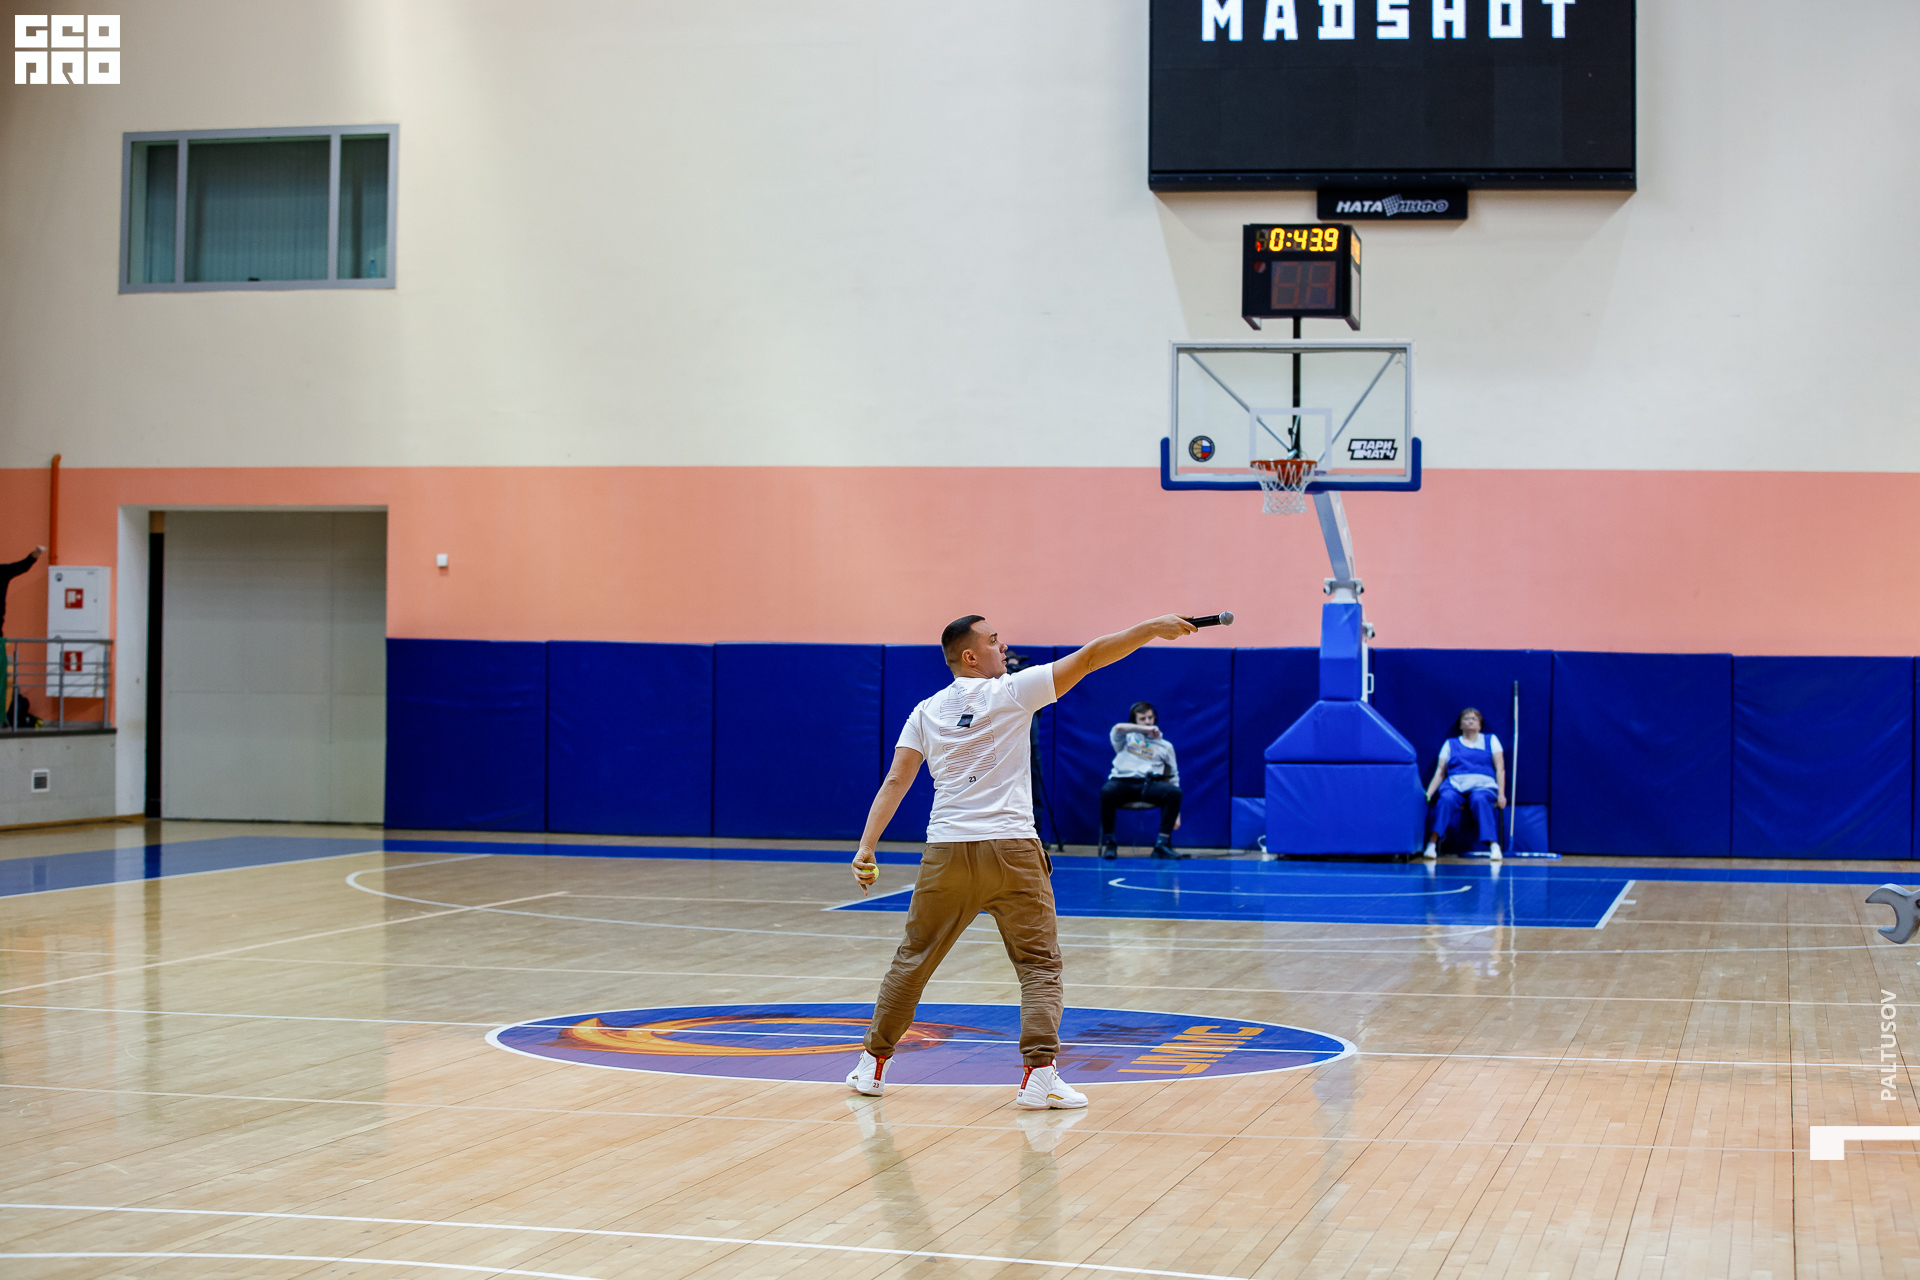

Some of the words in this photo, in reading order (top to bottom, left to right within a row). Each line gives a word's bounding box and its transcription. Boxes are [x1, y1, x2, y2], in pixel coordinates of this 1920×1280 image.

[1202, 0, 1575, 41] MADSHOT
[1269, 228, 1339, 252] 0:43.9
[1350, 440, 1393, 450] ПАРИ
[1353, 449, 1395, 459] МАТЧ
[1117, 1025, 1265, 1074] UMMC
